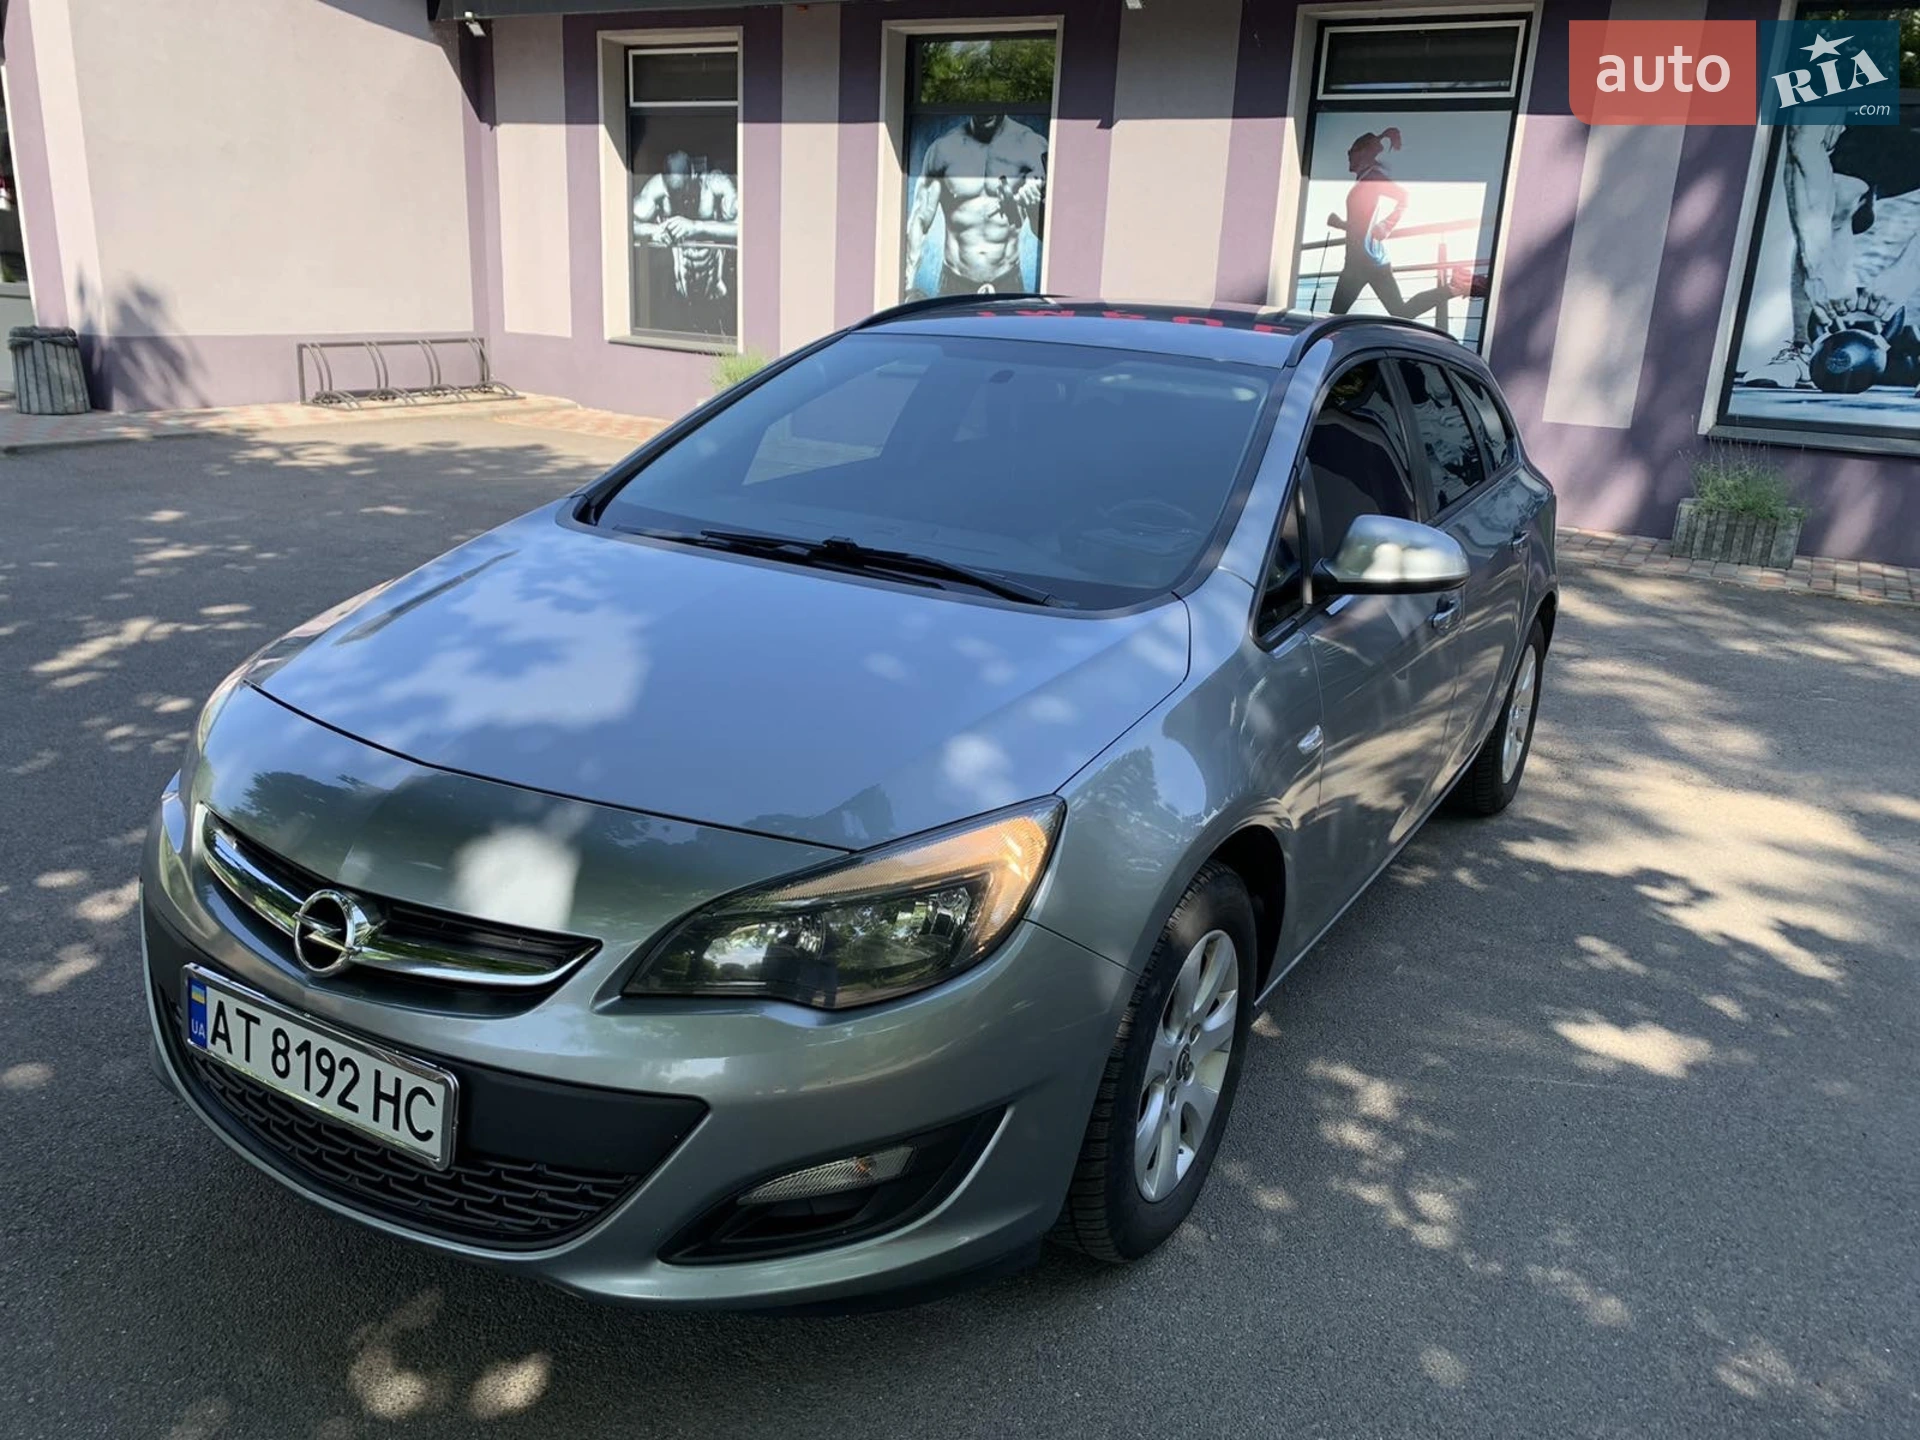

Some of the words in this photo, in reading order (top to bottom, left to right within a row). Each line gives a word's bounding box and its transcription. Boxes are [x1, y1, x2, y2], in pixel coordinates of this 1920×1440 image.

[191, 1017, 206, 1039] UA
[210, 1000, 261, 1063] AT
[271, 1027, 361, 1114] 8192
[372, 1069, 437, 1142] HC
